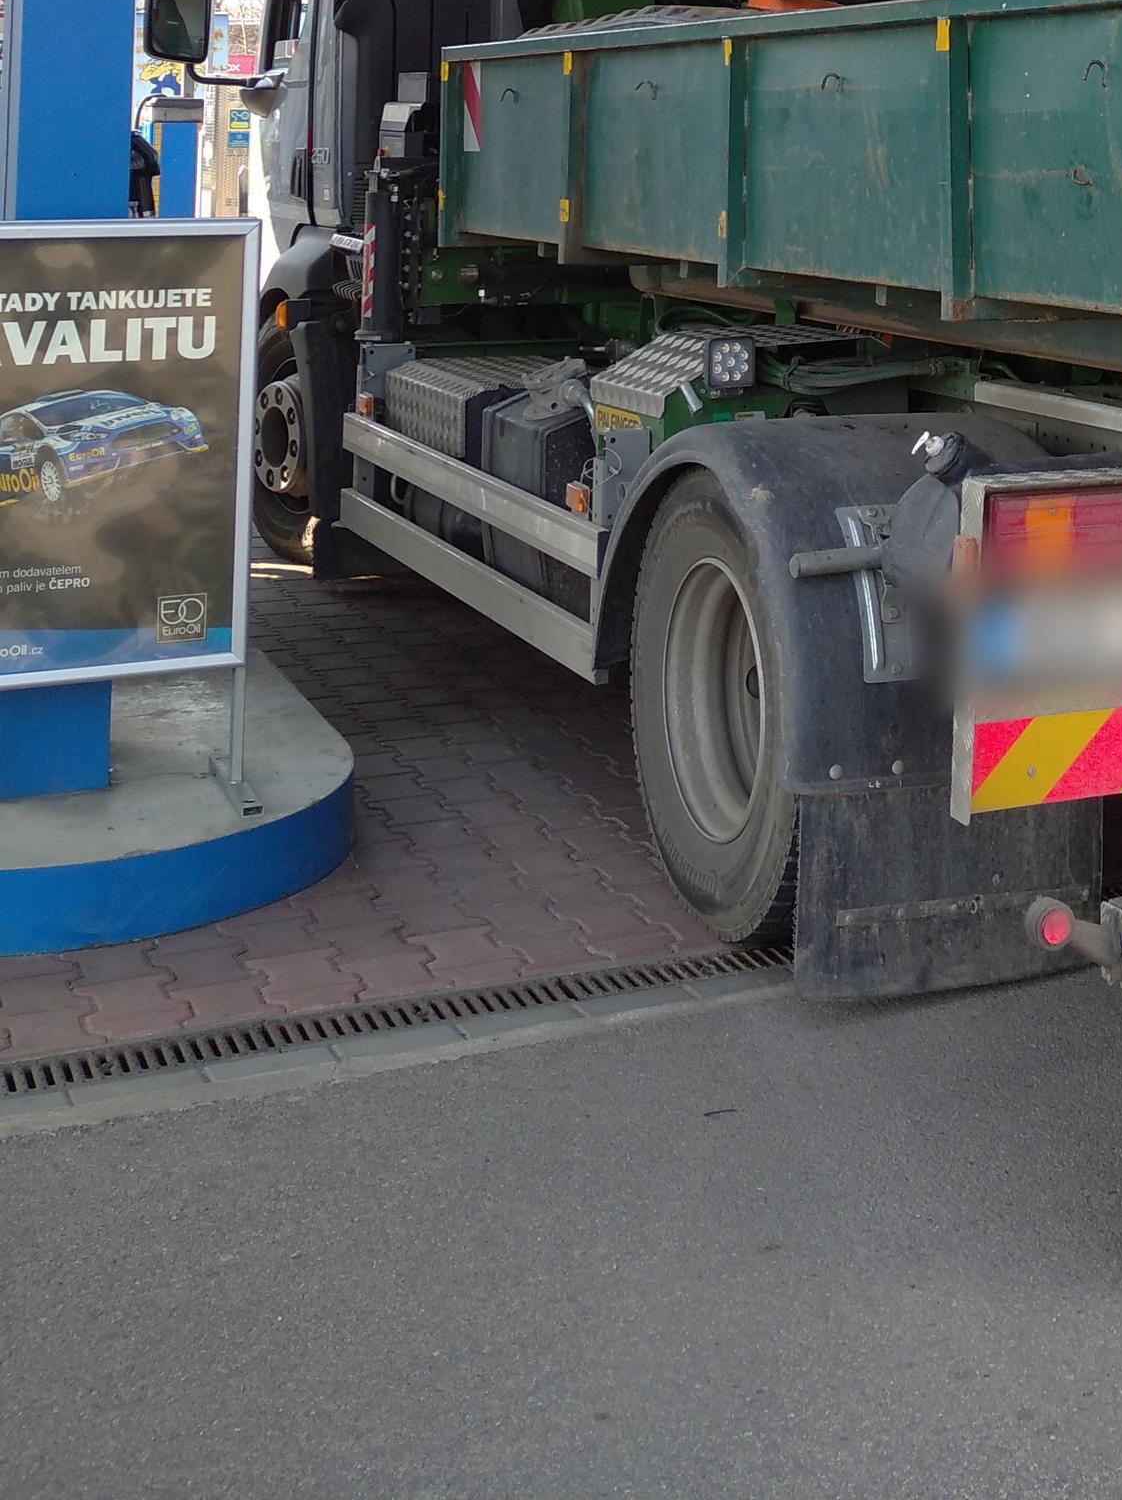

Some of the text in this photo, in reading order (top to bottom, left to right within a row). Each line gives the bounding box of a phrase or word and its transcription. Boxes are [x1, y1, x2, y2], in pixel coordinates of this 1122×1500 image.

[67, 288, 213, 311] TANKUJETE
[0, 315, 217, 368] VALITU
[68, 446, 106, 462] EuroOil
[13, 565, 81, 578] dodavatelem
[6, 581, 33, 595] paliv
[35, 581, 46, 594] je
[49, 577, 90, 590] ČEPRO
[162, 623, 201, 636] EuroOil
